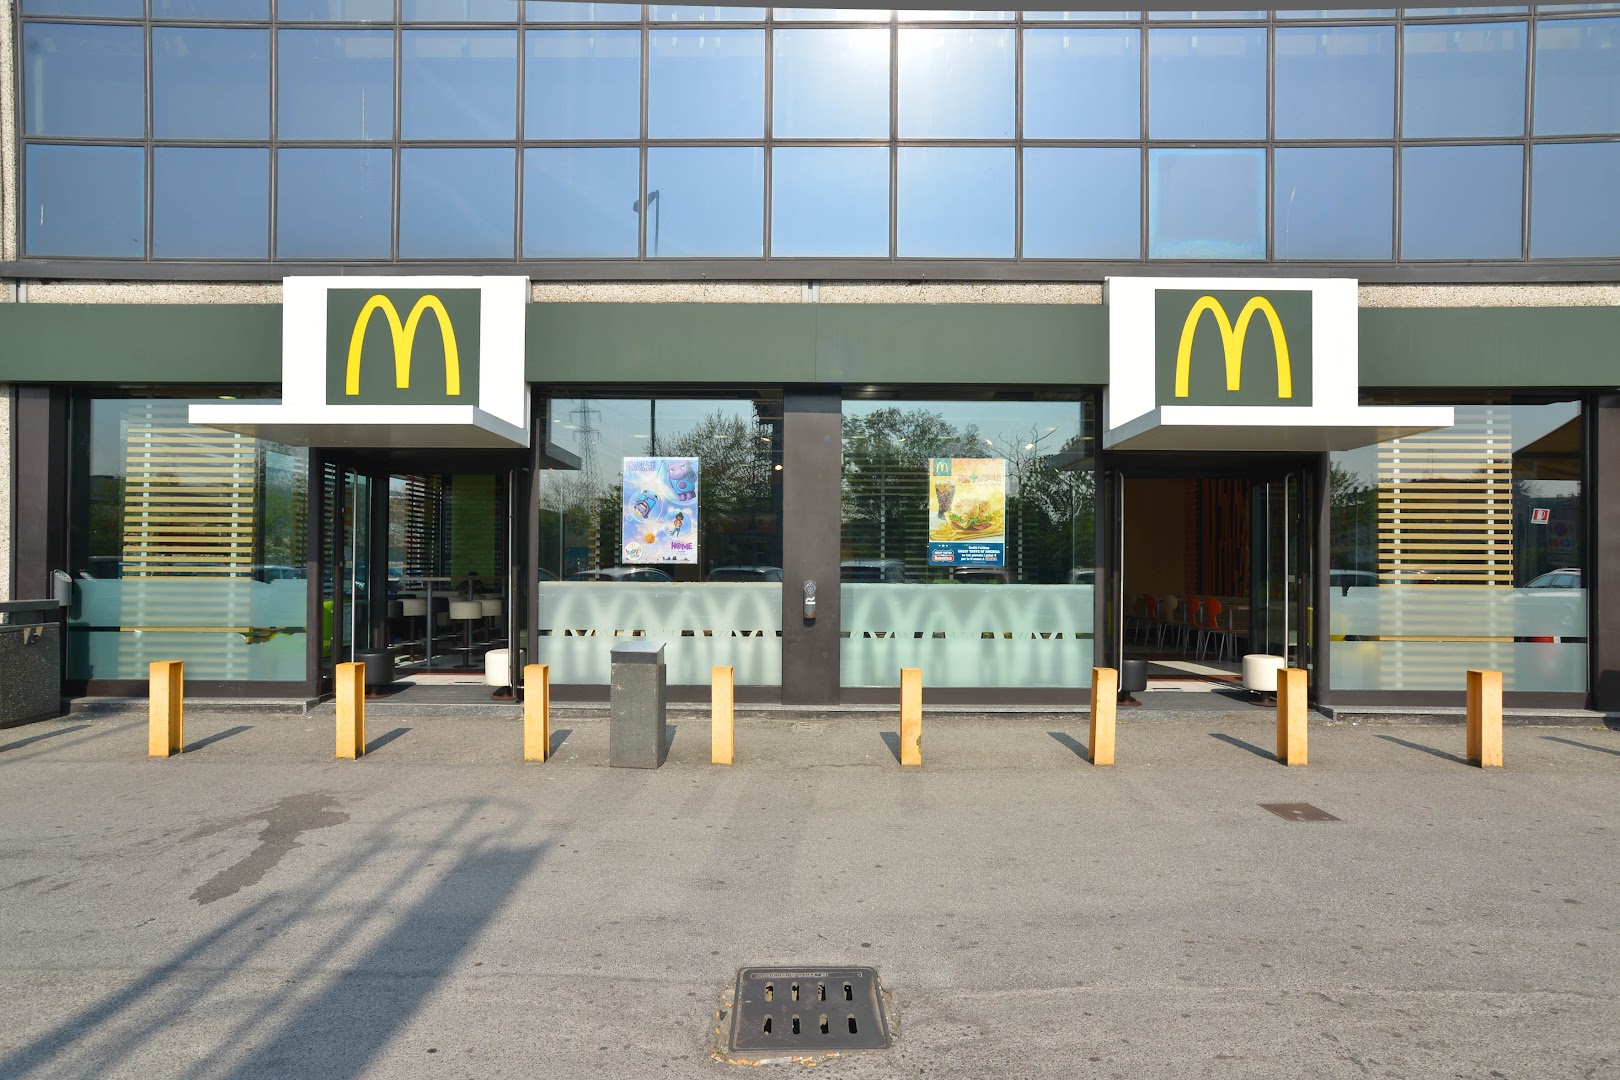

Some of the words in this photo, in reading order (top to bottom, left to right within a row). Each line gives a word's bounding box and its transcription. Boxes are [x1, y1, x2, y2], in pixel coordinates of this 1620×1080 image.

[345, 294, 460, 396] M
[1175, 295, 1292, 399] M
[671, 542, 692, 550] HOME
